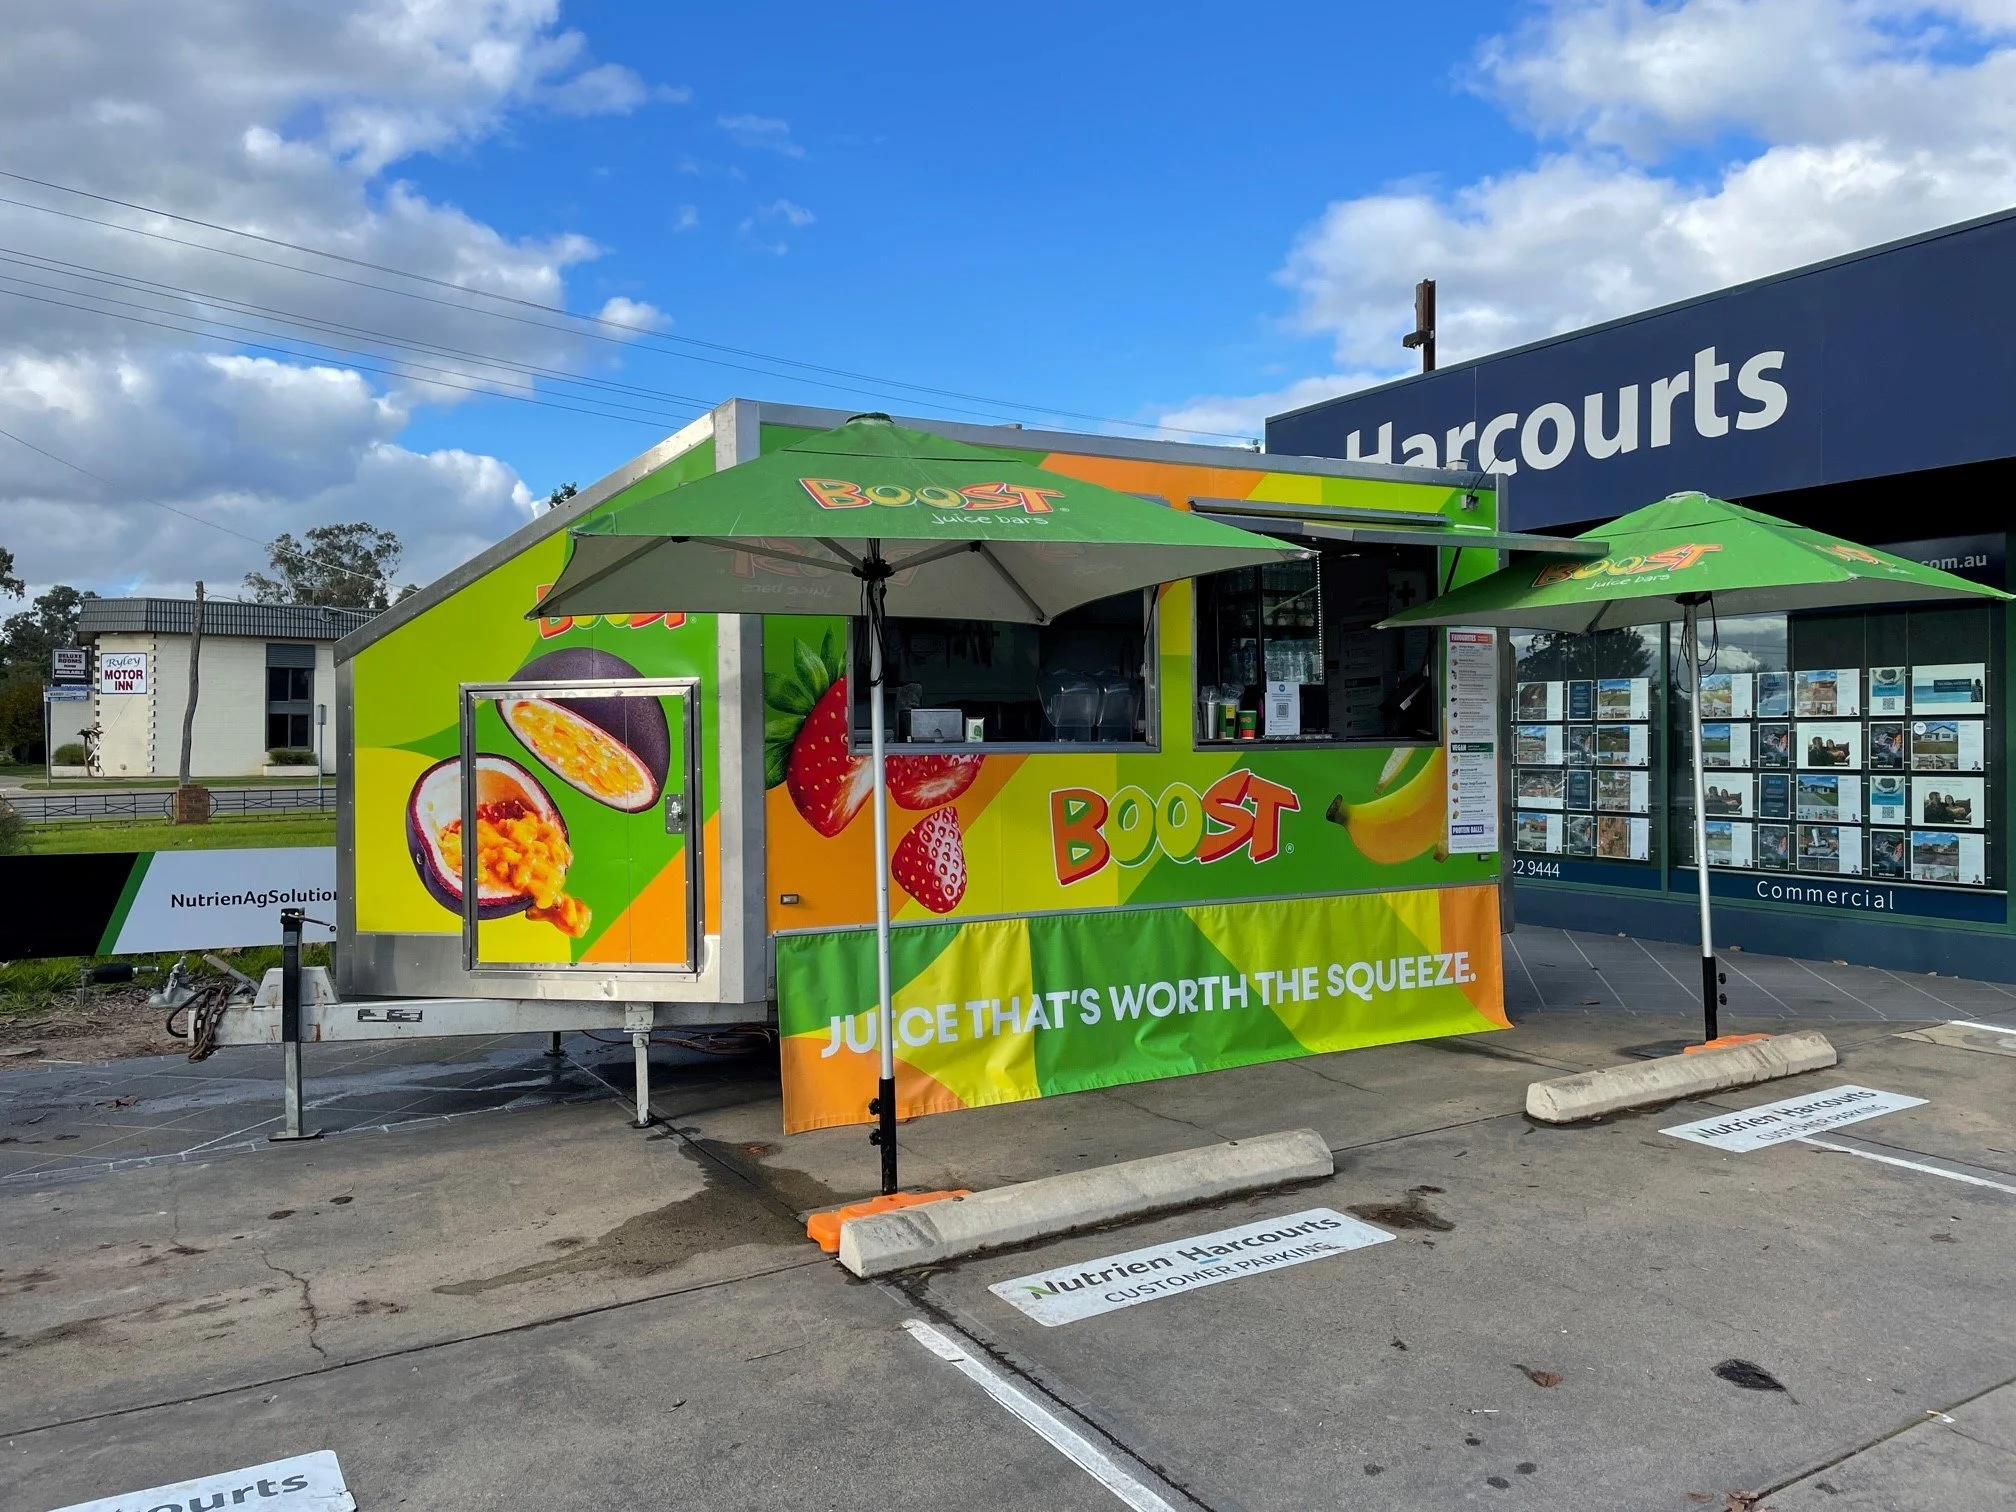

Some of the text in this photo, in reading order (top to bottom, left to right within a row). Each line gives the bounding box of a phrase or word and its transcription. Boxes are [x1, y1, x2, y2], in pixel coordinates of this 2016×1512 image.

[799, 478, 1065, 514] BOOST
[995, 514, 1049, 525] bars
[1532, 543, 1723, 588] BOOST
[1634, 574, 1670, 584] bars
[104, 670, 143, 680] MOTOR
[106, 655, 141, 669] Ryley
[115, 681, 133, 690] INN
[1050, 768, 1300, 887] BOOST
[1527, 860, 1560, 878] 9444
[171, 888, 337, 908] NutrienAgSolutio
[1756, 880, 1894, 910] Commercial
[965, 987, 1101, 1039] THAT'S
[1108, 974, 1248, 1021] WORTH
[1255, 967, 1319, 1006] THE
[1326, 952, 1477, 1001] SQUEEZE.
[1694, 1090, 1878, 1139] Nutrien Harcourts
[1756, 1104, 1890, 1141] CUSTOMER PARKING
[1021, 1216, 1343, 1300] Nutrien Harcourts
[1104, 1241, 1332, 1303] CUSTOMER PARKING
